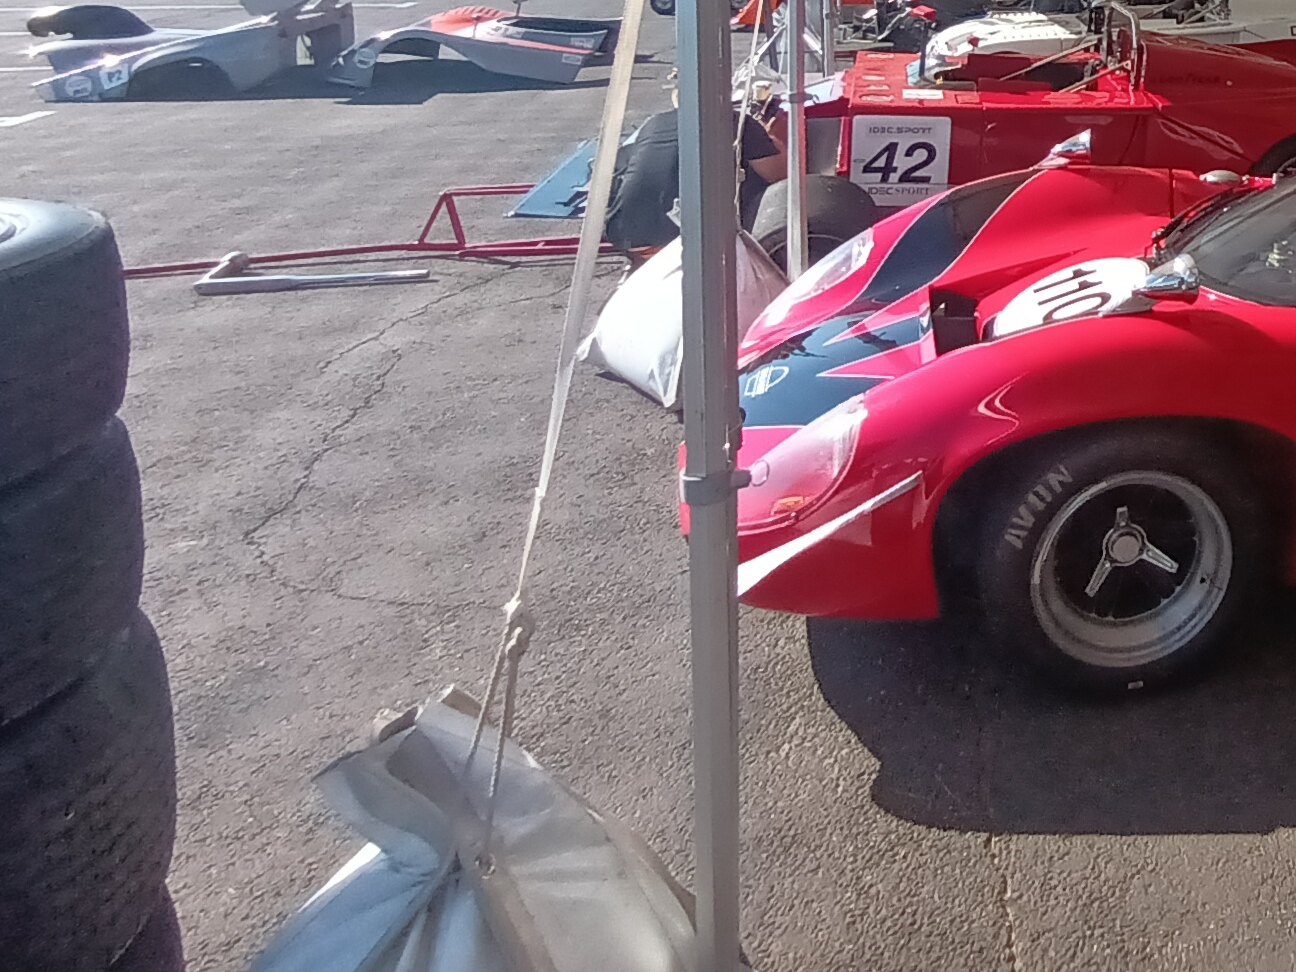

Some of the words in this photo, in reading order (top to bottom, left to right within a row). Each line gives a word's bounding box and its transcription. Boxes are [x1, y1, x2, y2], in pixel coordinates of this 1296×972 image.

[107, 69, 122, 83] P2
[862, 141, 937, 184] 42
[1033, 267, 1112, 325] 110
[1004, 464, 1073, 549] AVON
